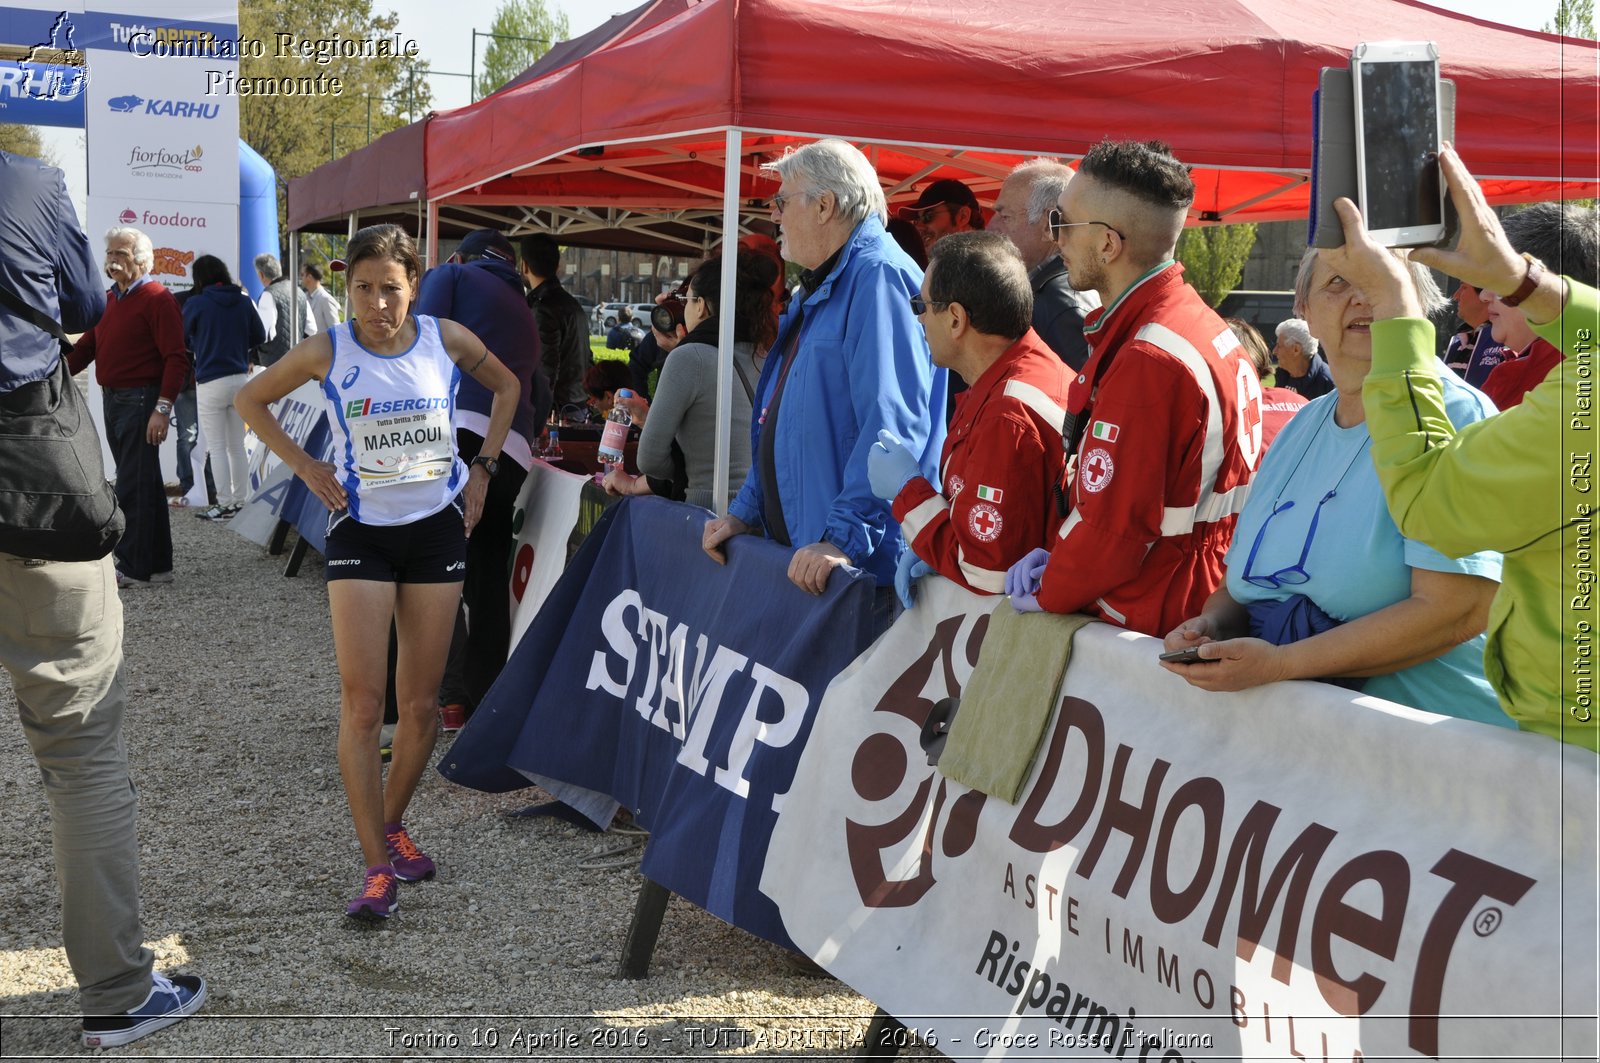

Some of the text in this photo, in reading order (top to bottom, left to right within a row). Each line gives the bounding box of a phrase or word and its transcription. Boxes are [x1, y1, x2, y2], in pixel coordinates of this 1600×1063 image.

[110, 23, 216, 51] TuttaDRITTA
[145, 98, 220, 119] KARHU
[127, 145, 190, 166] fiorfood
[143, 210, 207, 228] foodora
[370, 397, 449, 414] ESERCITO
[377, 413, 427, 427] Tutta Dritta 2016
[364, 426, 442, 451] MARAOUI
[586, 589, 809, 813] STAMP
[1003, 862, 1363, 1063] ASTE IMMOBILI
